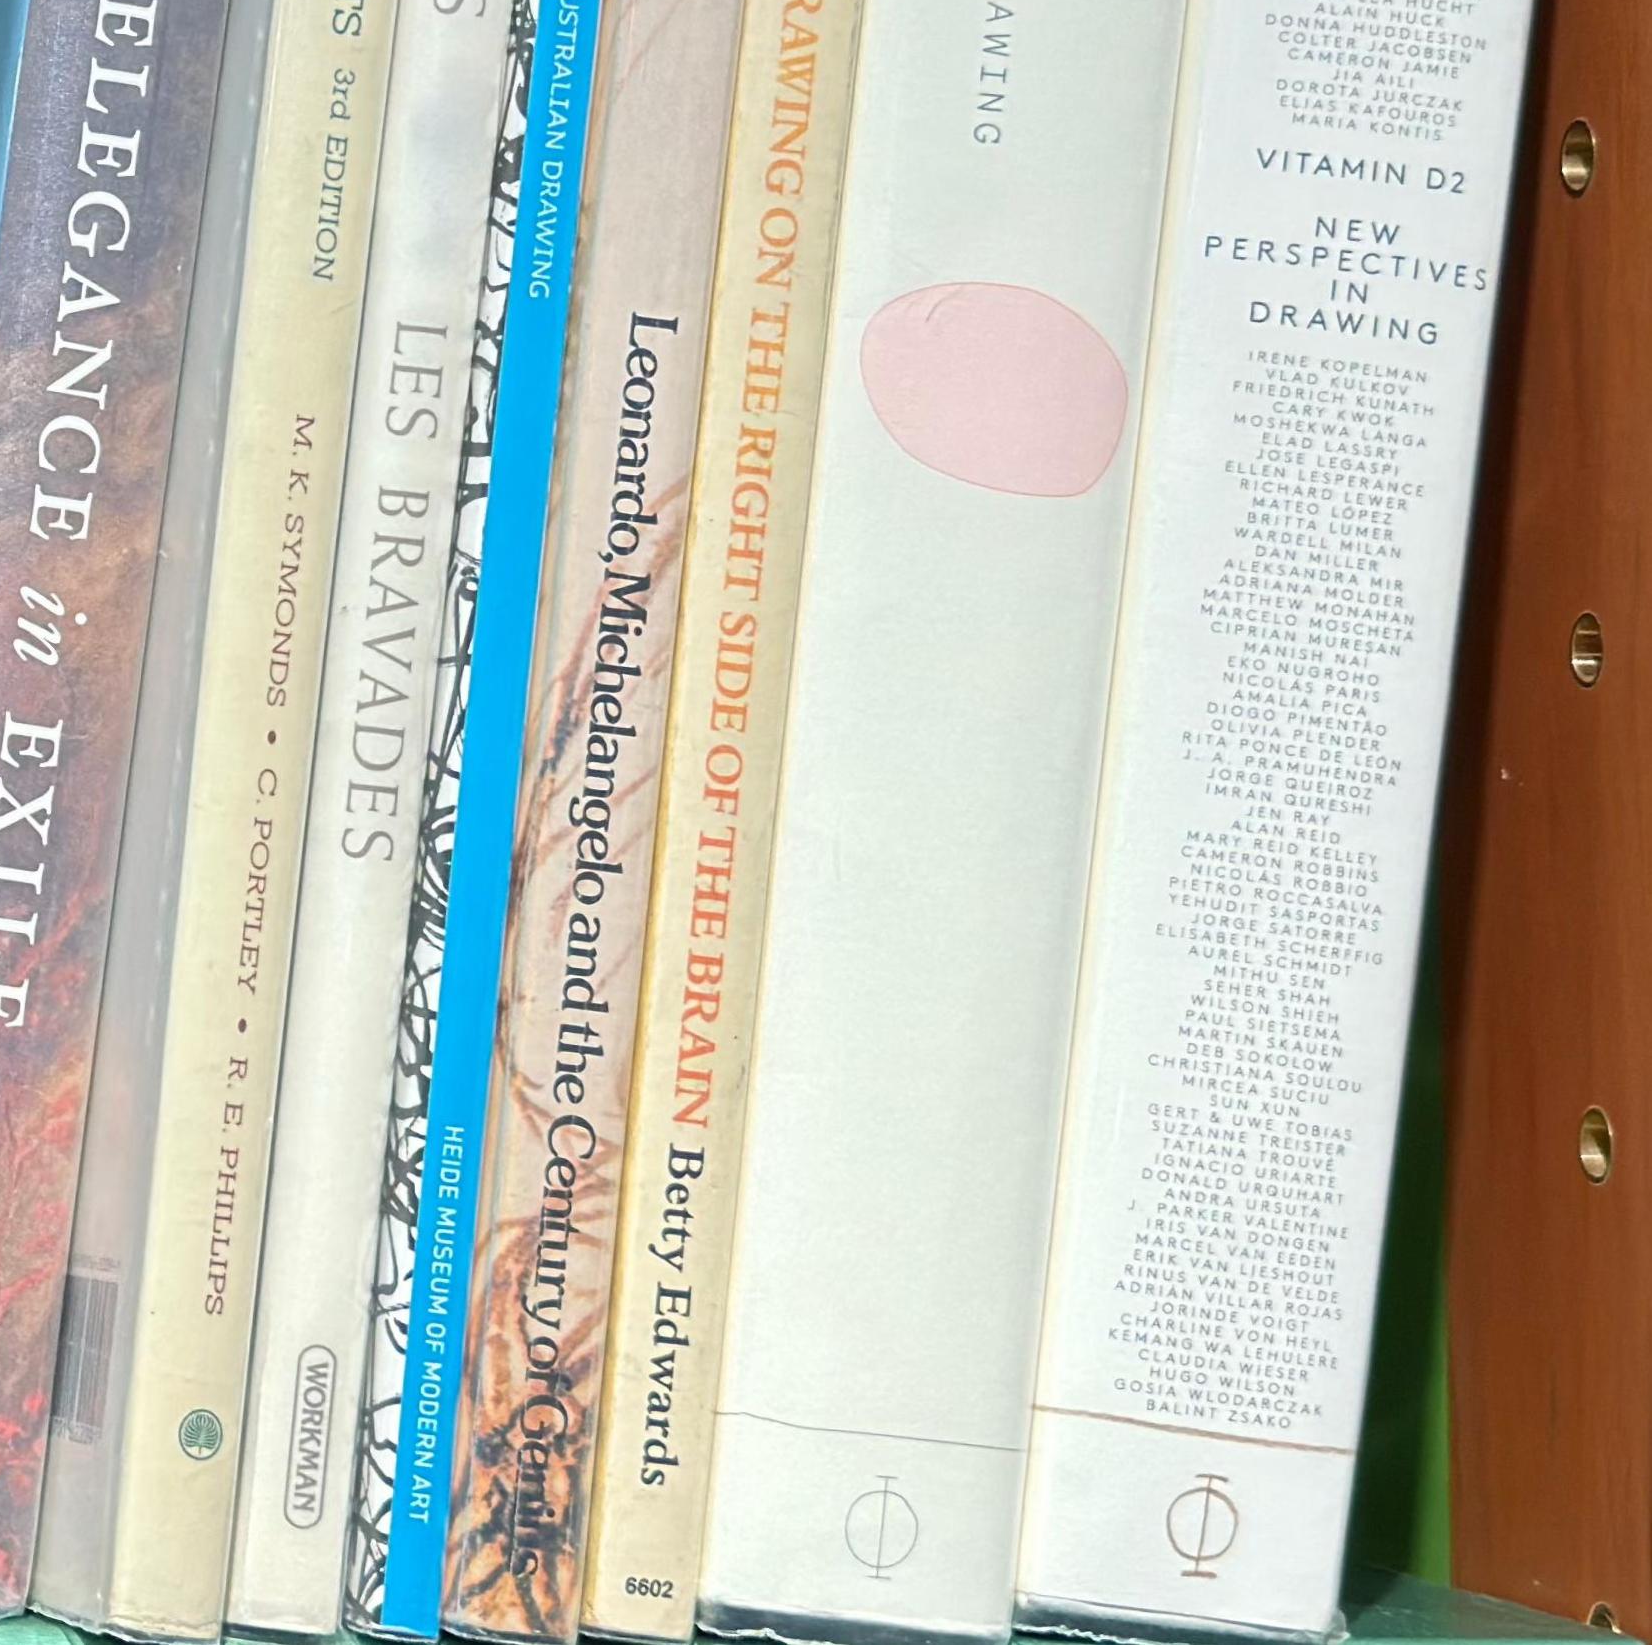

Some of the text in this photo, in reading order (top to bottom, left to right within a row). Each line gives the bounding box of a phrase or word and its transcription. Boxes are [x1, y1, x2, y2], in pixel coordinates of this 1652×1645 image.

[1277, 30, 1471, 63] COLTER JACOBSEN
[332, 66, 358, 121] 3rd
[1275, 78, 1462, 111] DOROTA JURCZAK
[1256, 148, 1464, 194] VITAMIN D2
[311, 134, 350, 282] EDITION
[528, 159, 563, 300] DRAWING
[1314, 216, 1400, 244] NEW
[755, 208, 800, 292] ON
[1204, 235, 1486, 289] PERSPECTIVES
[1330, 279, 1368, 304] IN
[1249, 301, 1437, 344] DRAWING
[740, 305, 790, 415] THE
[1248, 350, 1427, 382] IRENE KOPELMAN
[596, 309, 680, 566] Leonardo,
[1233, 413, 1426, 447] MOSHEKWA LANGA
[722, 423, 778, 601] RIGHT
[1239, 477, 1407, 510] RICHARD LEWER
[1233, 527, 1401, 558] WARDELL MILAN
[341, 319, 449, 863] LES BRAVADES
[1223, 558, 1403, 591] ALEKSANDRA MIR
[14, 588, 87, 666] in
[708, 611, 757, 734] SIDE
[1226, 654, 1380, 686] EKO NUGROHO
[566, 567, 652, 904] Michelangelo
[701, 743, 744, 819] OF
[1206, 767, 1372, 800] JORGE QUEIROZ
[204, 413, 316, 1318] M. K. SYMONDS C. PORTLEY R. E. PHILLIPS
[1186, 830, 1377, 865] MARY REID KELLEY
[690, 825, 739, 940] THE
[1168, 893, 1379, 932] YEHUDIT SASPORTAS
[556, 914, 609, 1020] and
[1212, 964, 1325, 989] MITHU SEN
[673, 951, 725, 1128] BRAIN
[1185, 1008, 1341, 1040] PAUL SIETSEMA
[553, 1022, 604, 1105] the
[1147, 1053, 1274, 1080] CHRISTIANA
[519, 1114, 597, 1334] Century
[1123, 1263, 1339, 1304] RINUS VAN DE VELDE
[408, 1125, 465, 1525] HEIDE MUSEUM OF MODERN ART
[639, 1142, 706, 1487] Betty Edwards
[1119, 1312, 1331, 1352] CHARLINE VON HEYL
[526, 1336, 572, 1392] of
[1148, 1366, 1294, 1396] HUGO WILSON
[292, 1360, 330, 1515] WORKMAN
[624, 1575, 675, 1601] 6602
